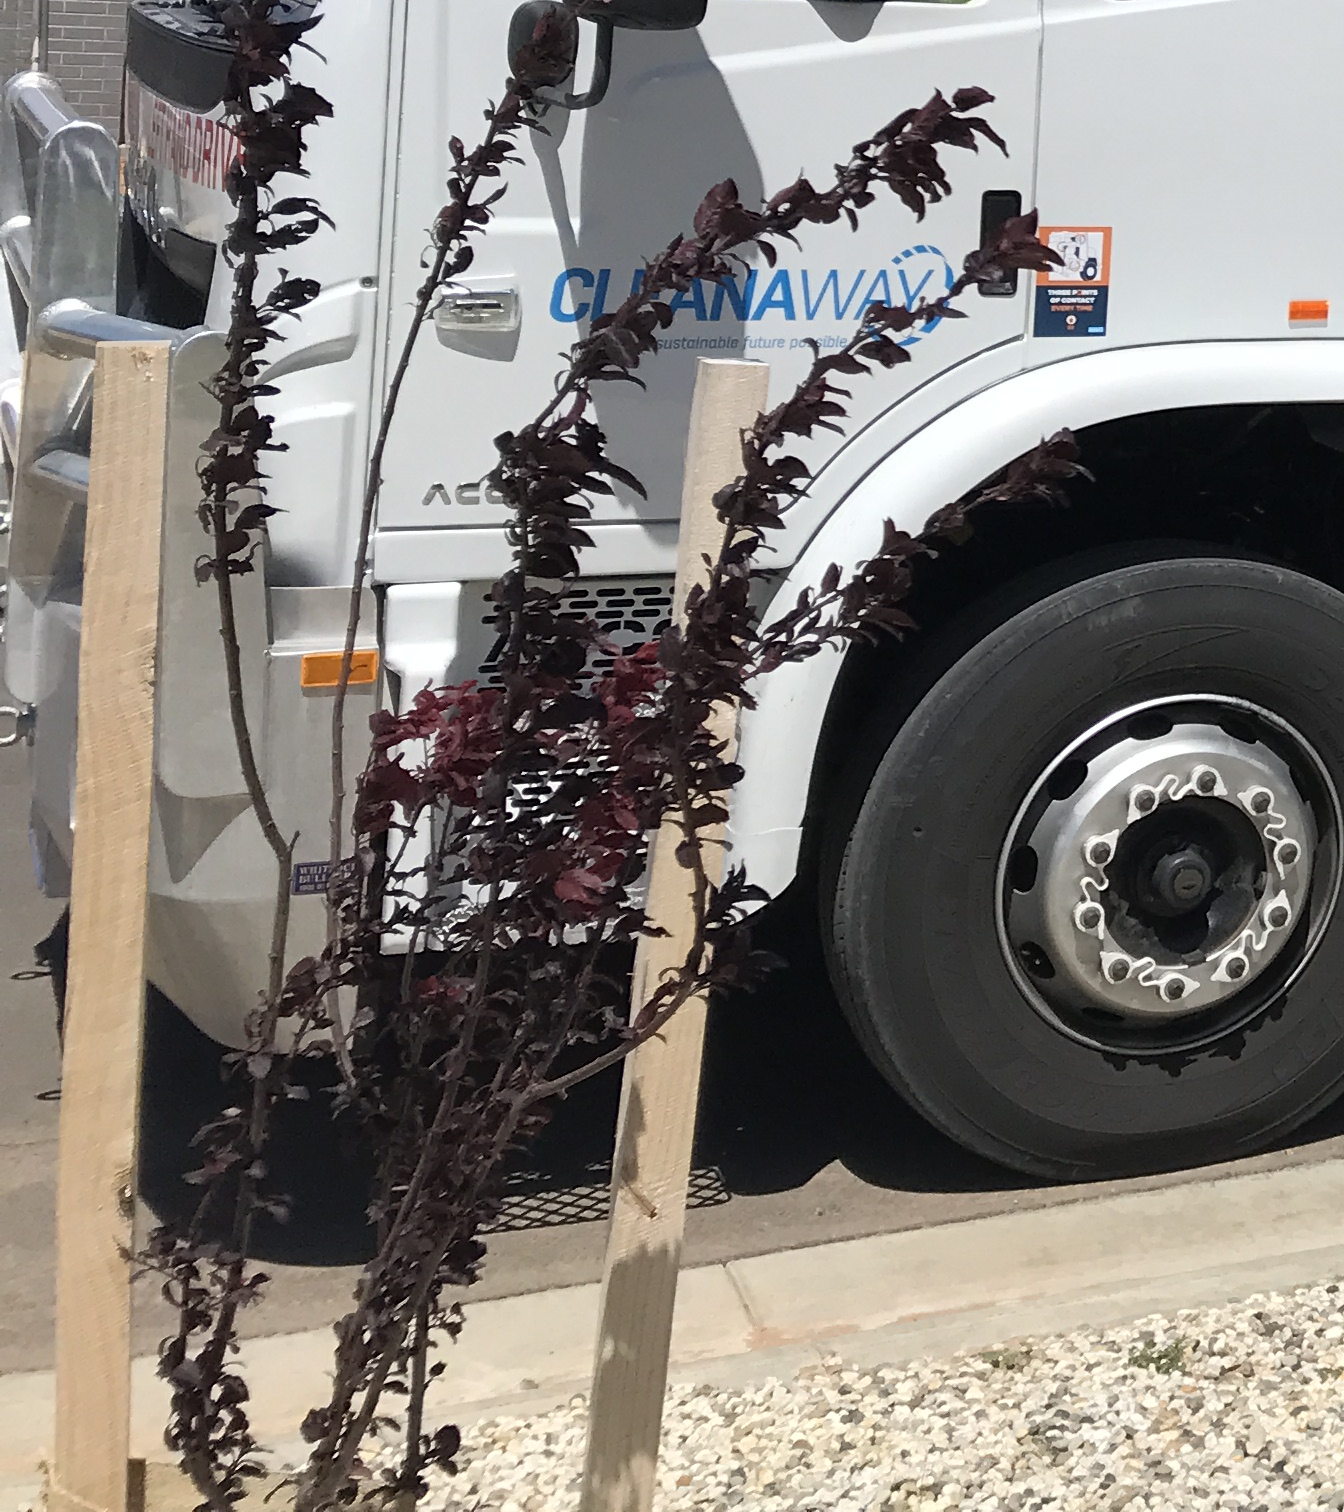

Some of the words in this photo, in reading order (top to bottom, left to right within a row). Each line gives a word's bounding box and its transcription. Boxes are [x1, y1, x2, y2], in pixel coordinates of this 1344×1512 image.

[656, 336, 738, 350] sustainable
[742, 336, 785, 351] future
[788, 336, 848, 350] posible
